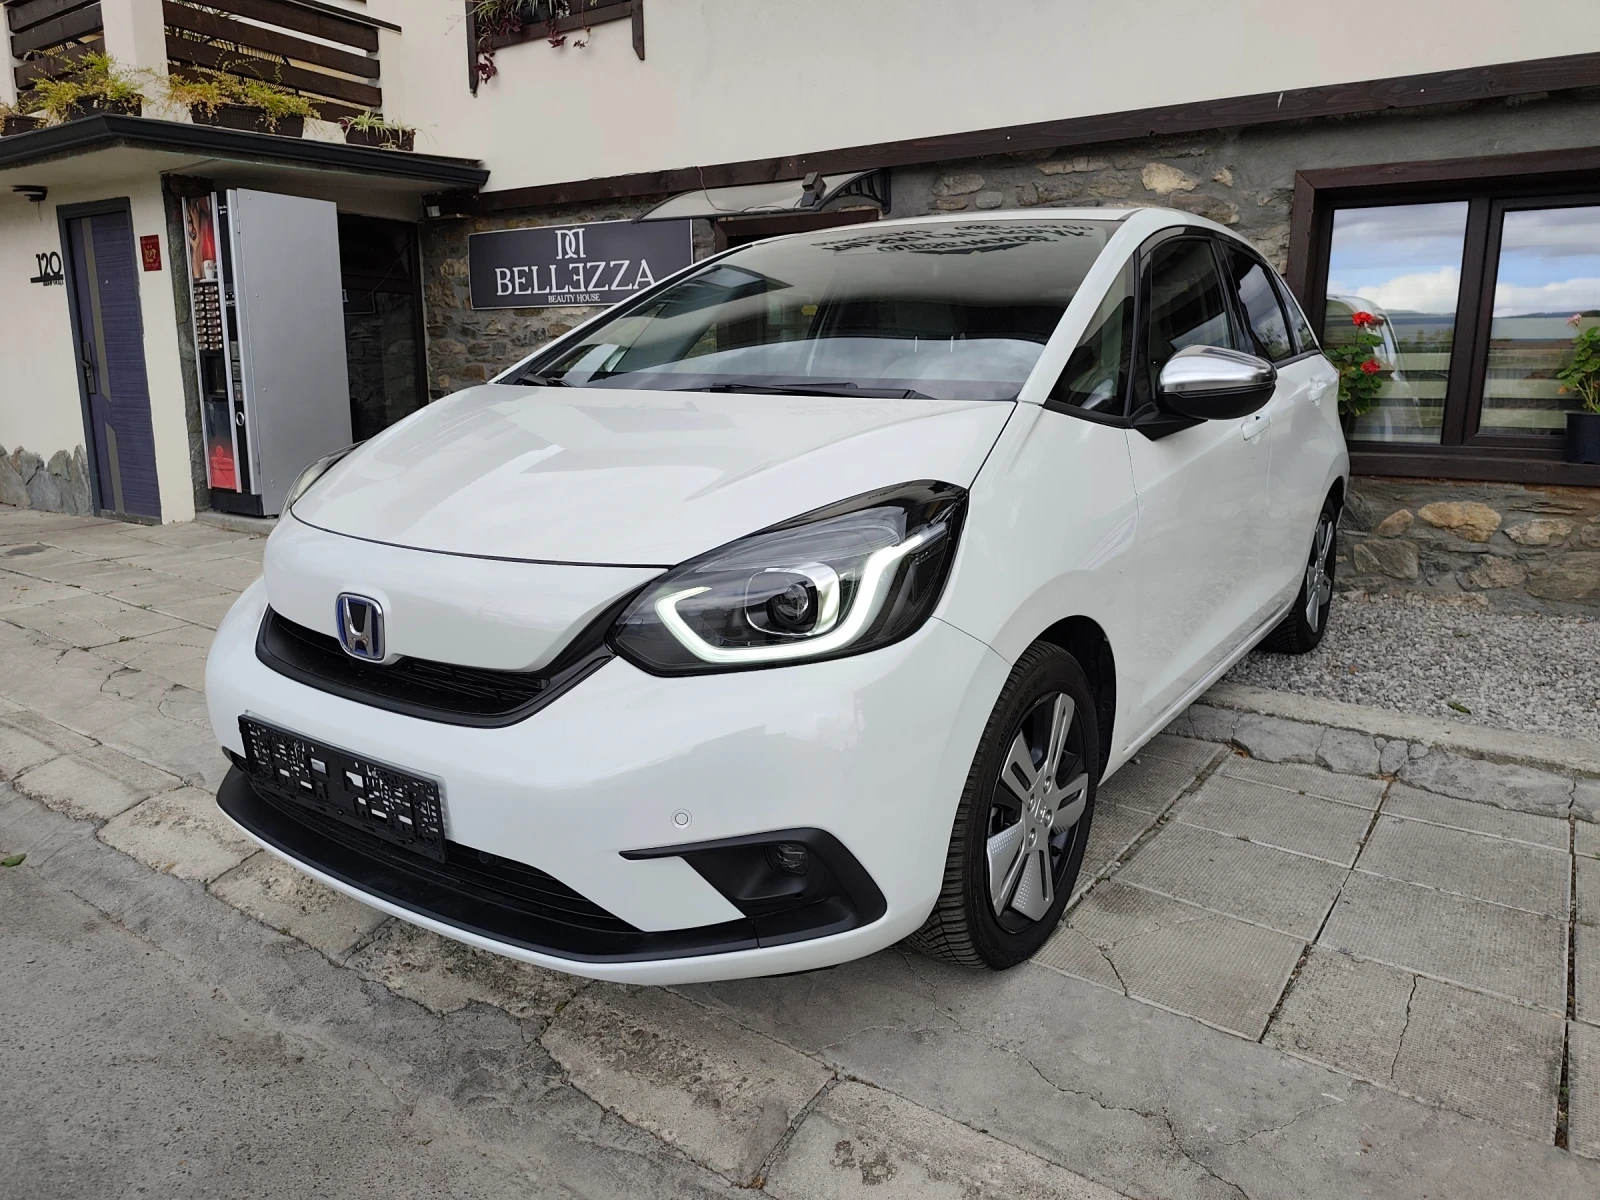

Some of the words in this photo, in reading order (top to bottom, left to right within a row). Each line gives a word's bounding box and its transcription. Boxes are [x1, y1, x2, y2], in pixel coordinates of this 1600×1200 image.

[35, 251, 62, 277] 120
[548, 294, 576, 304] BEAUTY
[577, 293, 600, 303] HOUSE
